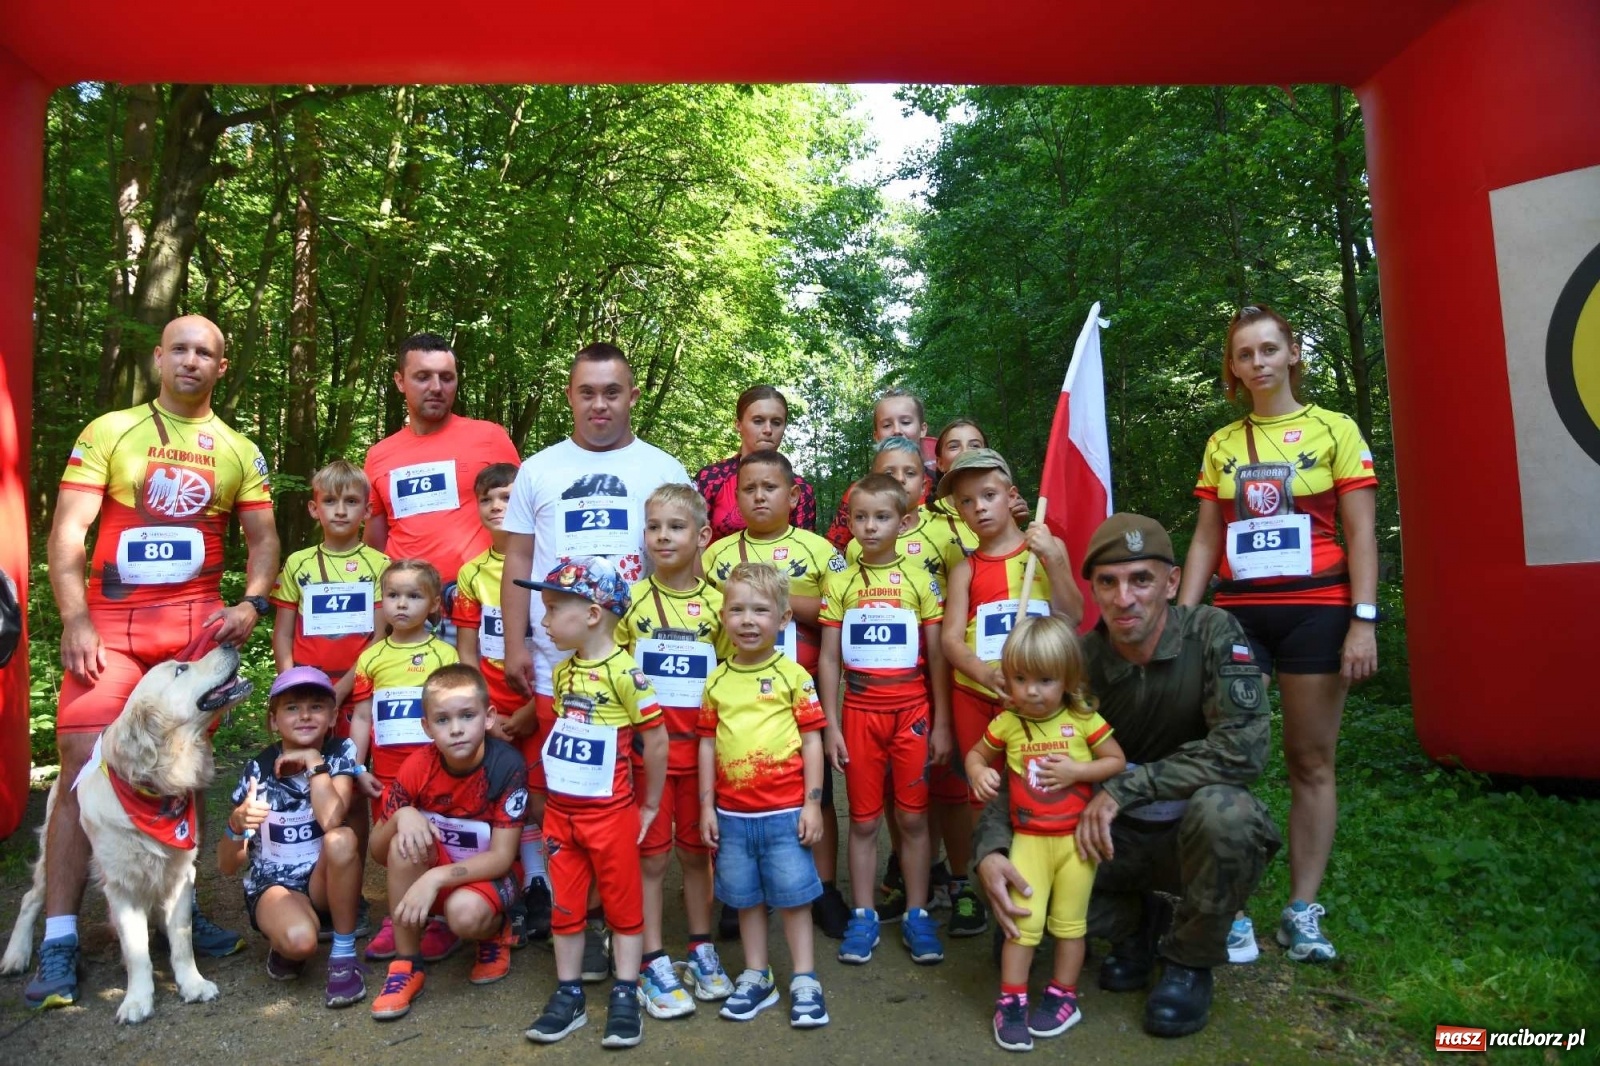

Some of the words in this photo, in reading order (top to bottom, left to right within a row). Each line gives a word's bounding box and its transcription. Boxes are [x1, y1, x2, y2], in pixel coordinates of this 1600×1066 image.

[147, 446, 216, 468] RACIBORKI
[1240, 468, 1288, 478] RACIBORKI
[408, 476, 432, 493] 76
[582, 510, 611, 528] 23
[1252, 531, 1281, 549] 85
[144, 543, 174, 559] 80
[857, 588, 901, 597] RACIBORKI
[325, 595, 352, 611] 47
[863, 625, 891, 642] 40
[659, 655, 690, 675] 45
[387, 700, 414, 717] 77
[555, 739, 592, 761] 113
[1020, 740, 1069, 752] RACIBORKI
[283, 824, 313, 842] 96
